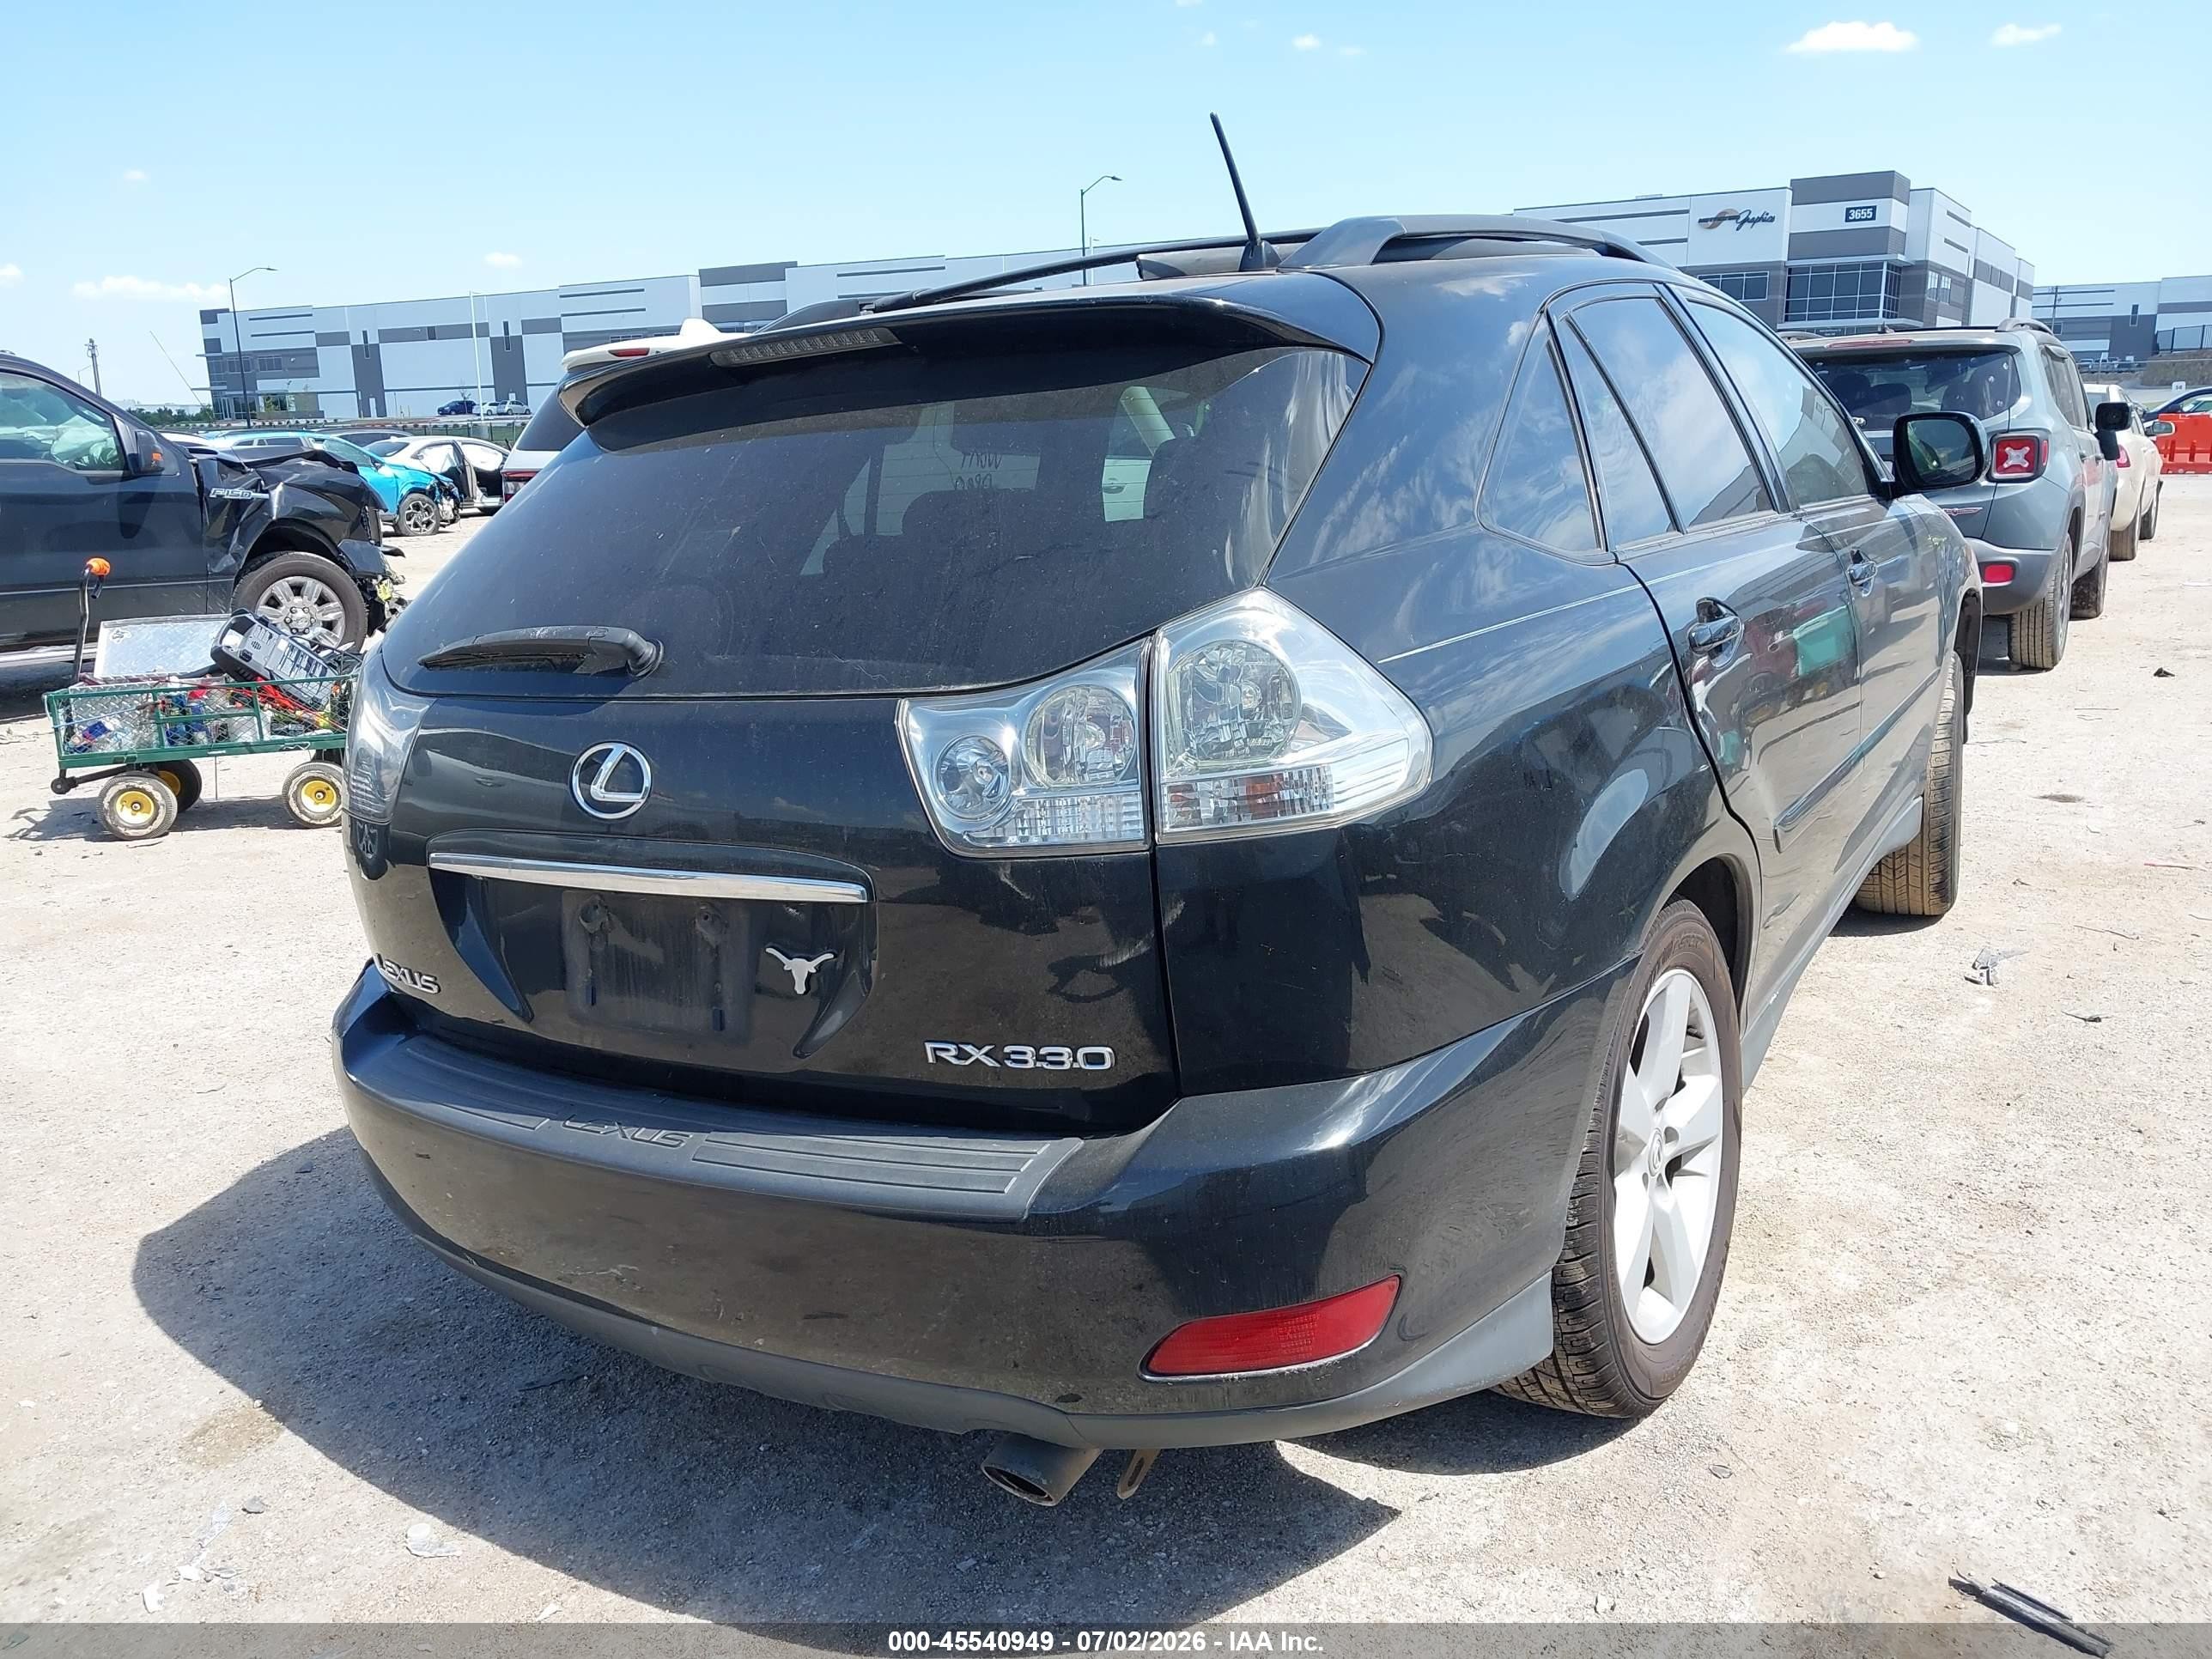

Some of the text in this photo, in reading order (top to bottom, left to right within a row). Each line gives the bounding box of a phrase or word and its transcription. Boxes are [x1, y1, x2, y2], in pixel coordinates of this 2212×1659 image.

[1849, 208, 1874, 220] 3655
[374, 953, 441, 994] LEXUS
[562, 1115, 693, 1148] LEXUS
